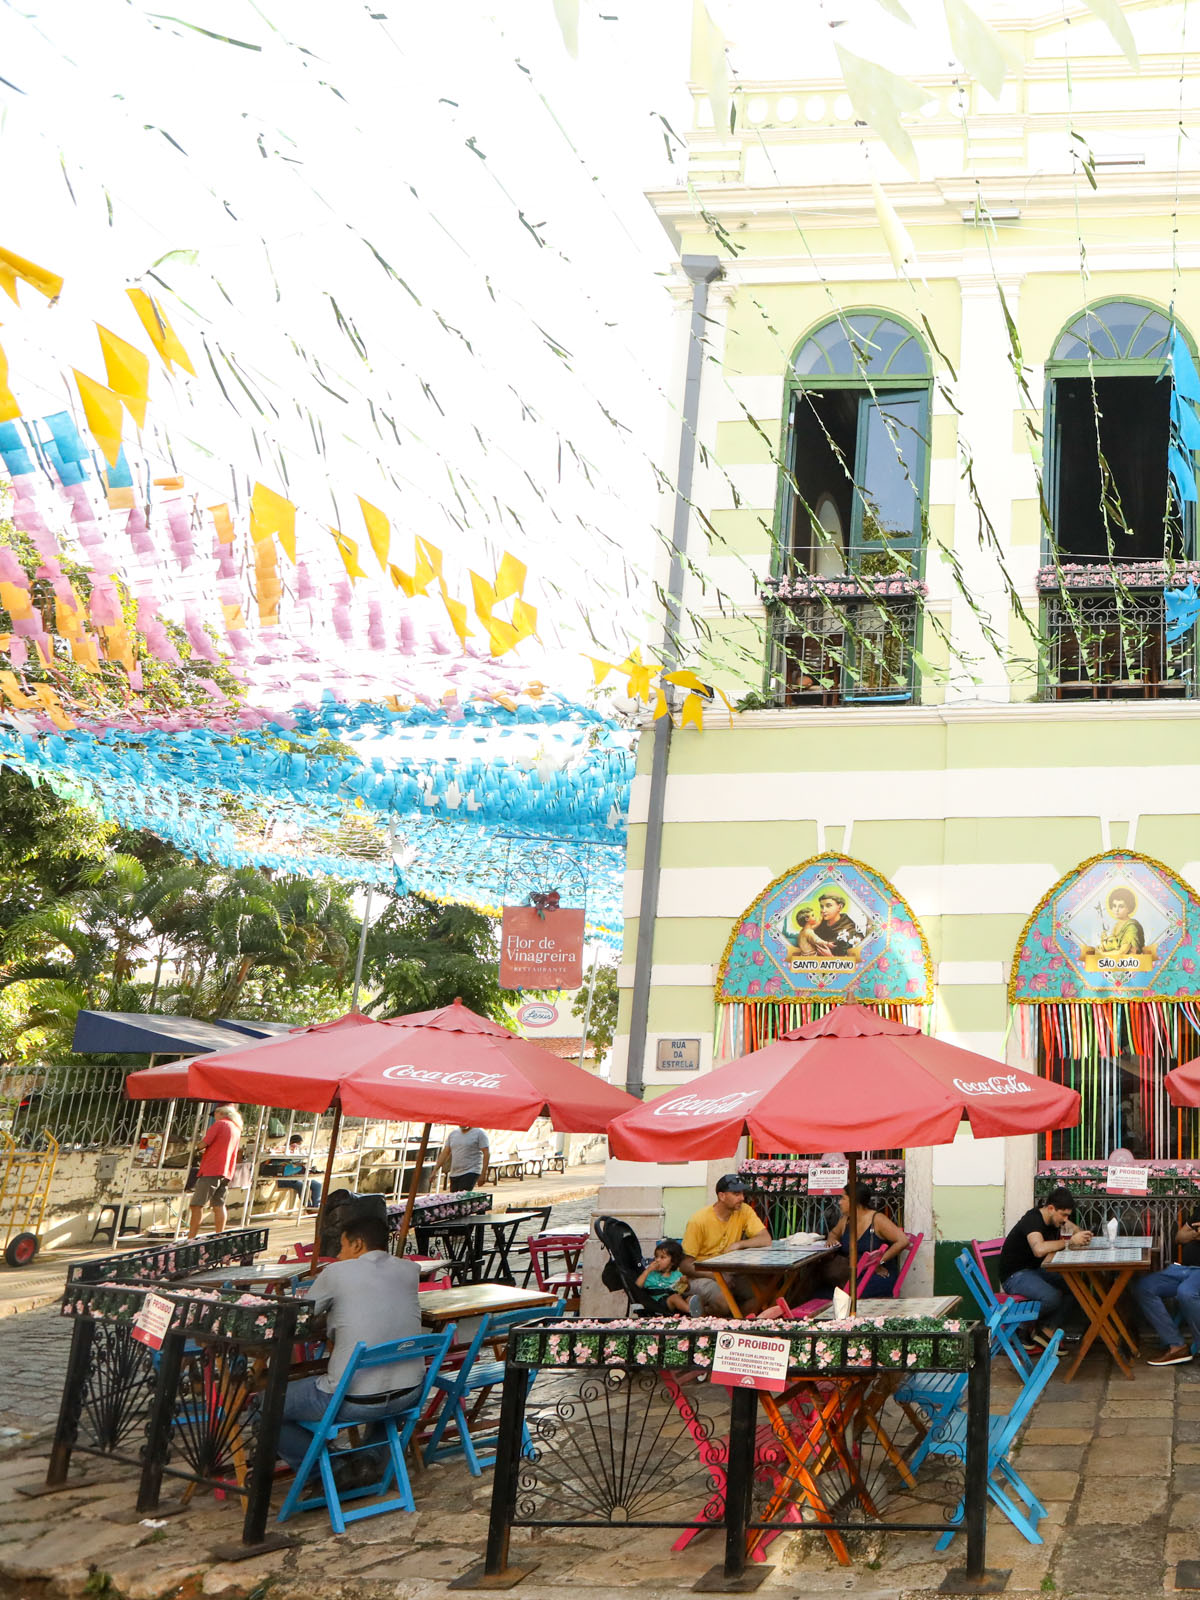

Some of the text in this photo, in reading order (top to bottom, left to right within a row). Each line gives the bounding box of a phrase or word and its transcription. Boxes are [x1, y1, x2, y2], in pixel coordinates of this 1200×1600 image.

[507, 935, 556, 950] Flor de
[506, 949, 576, 963] Vinagreira
[1098, 957, 1139, 968] SÃO JOÃO
[793, 959, 854, 970] SANTO ANTÔNIO
[671, 1041, 687, 1049] RUA
[662, 1060, 694, 1068] ESTRELA
[382, 1064, 507, 1089] Coca-Cola
[952, 1074, 1033, 1096] Coca-Cola
[653, 1089, 761, 1116] Coca-Cola
[737, 1338, 785, 1353] PROIBIDO
